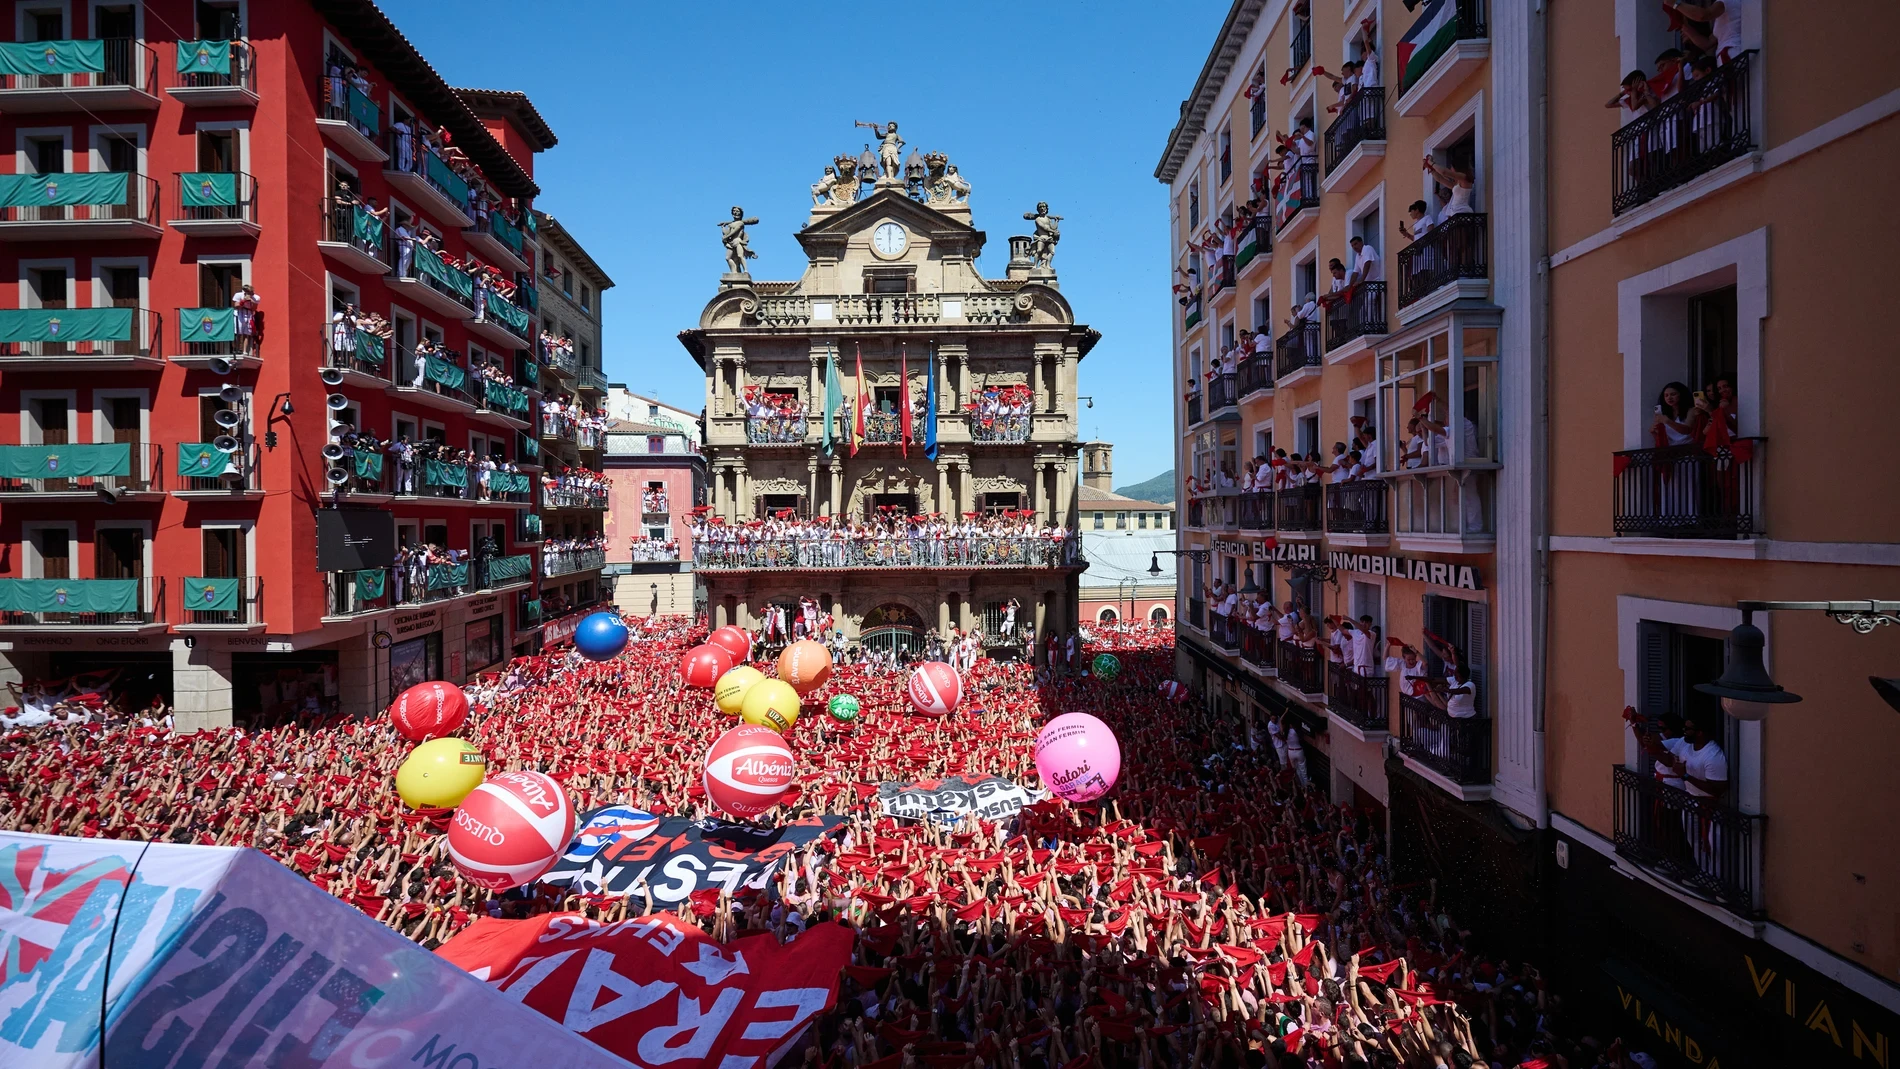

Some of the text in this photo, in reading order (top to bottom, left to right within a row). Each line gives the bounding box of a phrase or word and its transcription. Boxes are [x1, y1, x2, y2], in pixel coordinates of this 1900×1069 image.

[1211, 540, 1476, 591] AGENCIA ELIZARI INMOBILIARIA
[23, 637, 72, 646] BIENVENIDO
[96, 637, 149, 646] ONGI ETORRI
[227, 637, 272, 646] BIENVENUE
[1057, 724, 1085, 733] FERMIN
[1045, 736, 1058, 746] SAN
[1058, 730, 1086, 740] FERMIN
[735, 757, 792, 777] Albéniz
[1052, 759, 1091, 786] Satori
[455, 808, 505, 846] QUESOS
